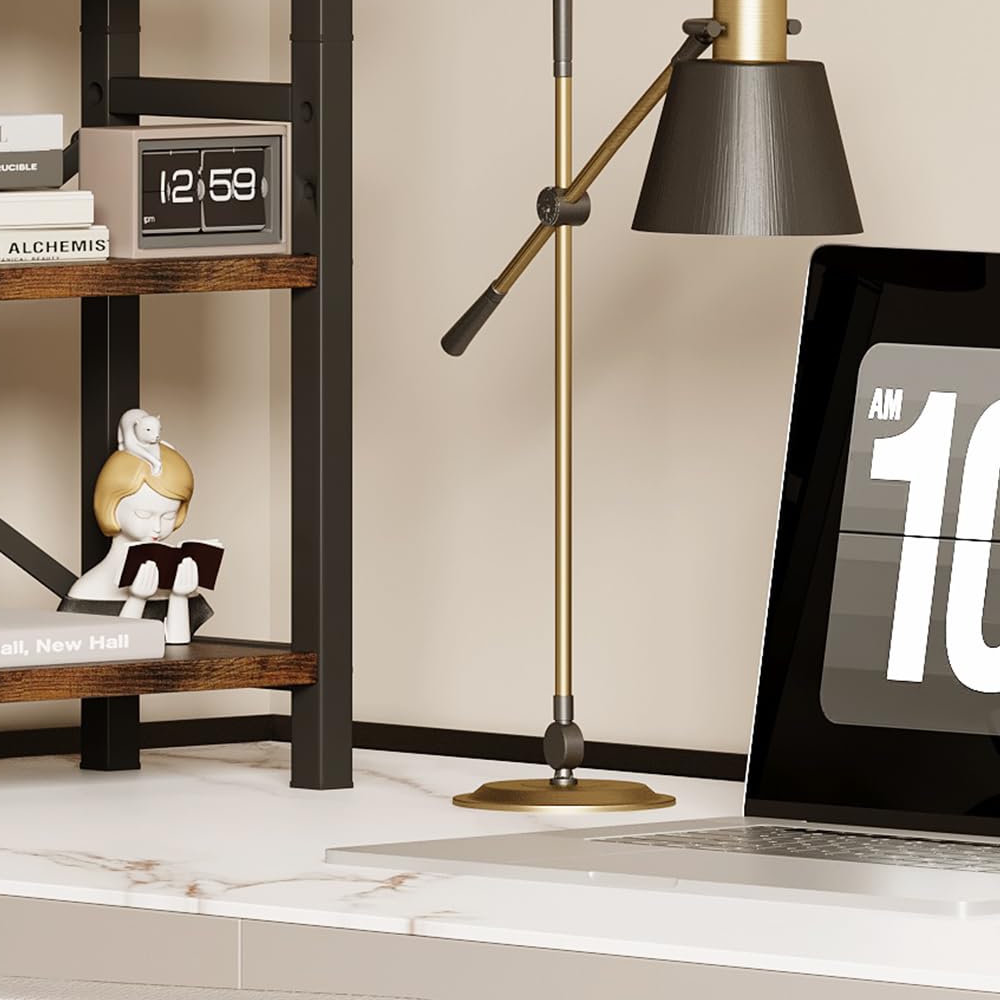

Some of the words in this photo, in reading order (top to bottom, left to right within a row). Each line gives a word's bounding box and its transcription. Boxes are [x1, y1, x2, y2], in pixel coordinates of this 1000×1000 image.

[161, 170, 193, 203] 12
[210, 168, 255, 201] 59
[143, 216, 156, 224] pm
[8, 239, 109, 255] ALCHEMIS
[867, 388, 904, 421] AM
[35, 636, 82, 654] New
[89, 633, 130, 651] Hall
